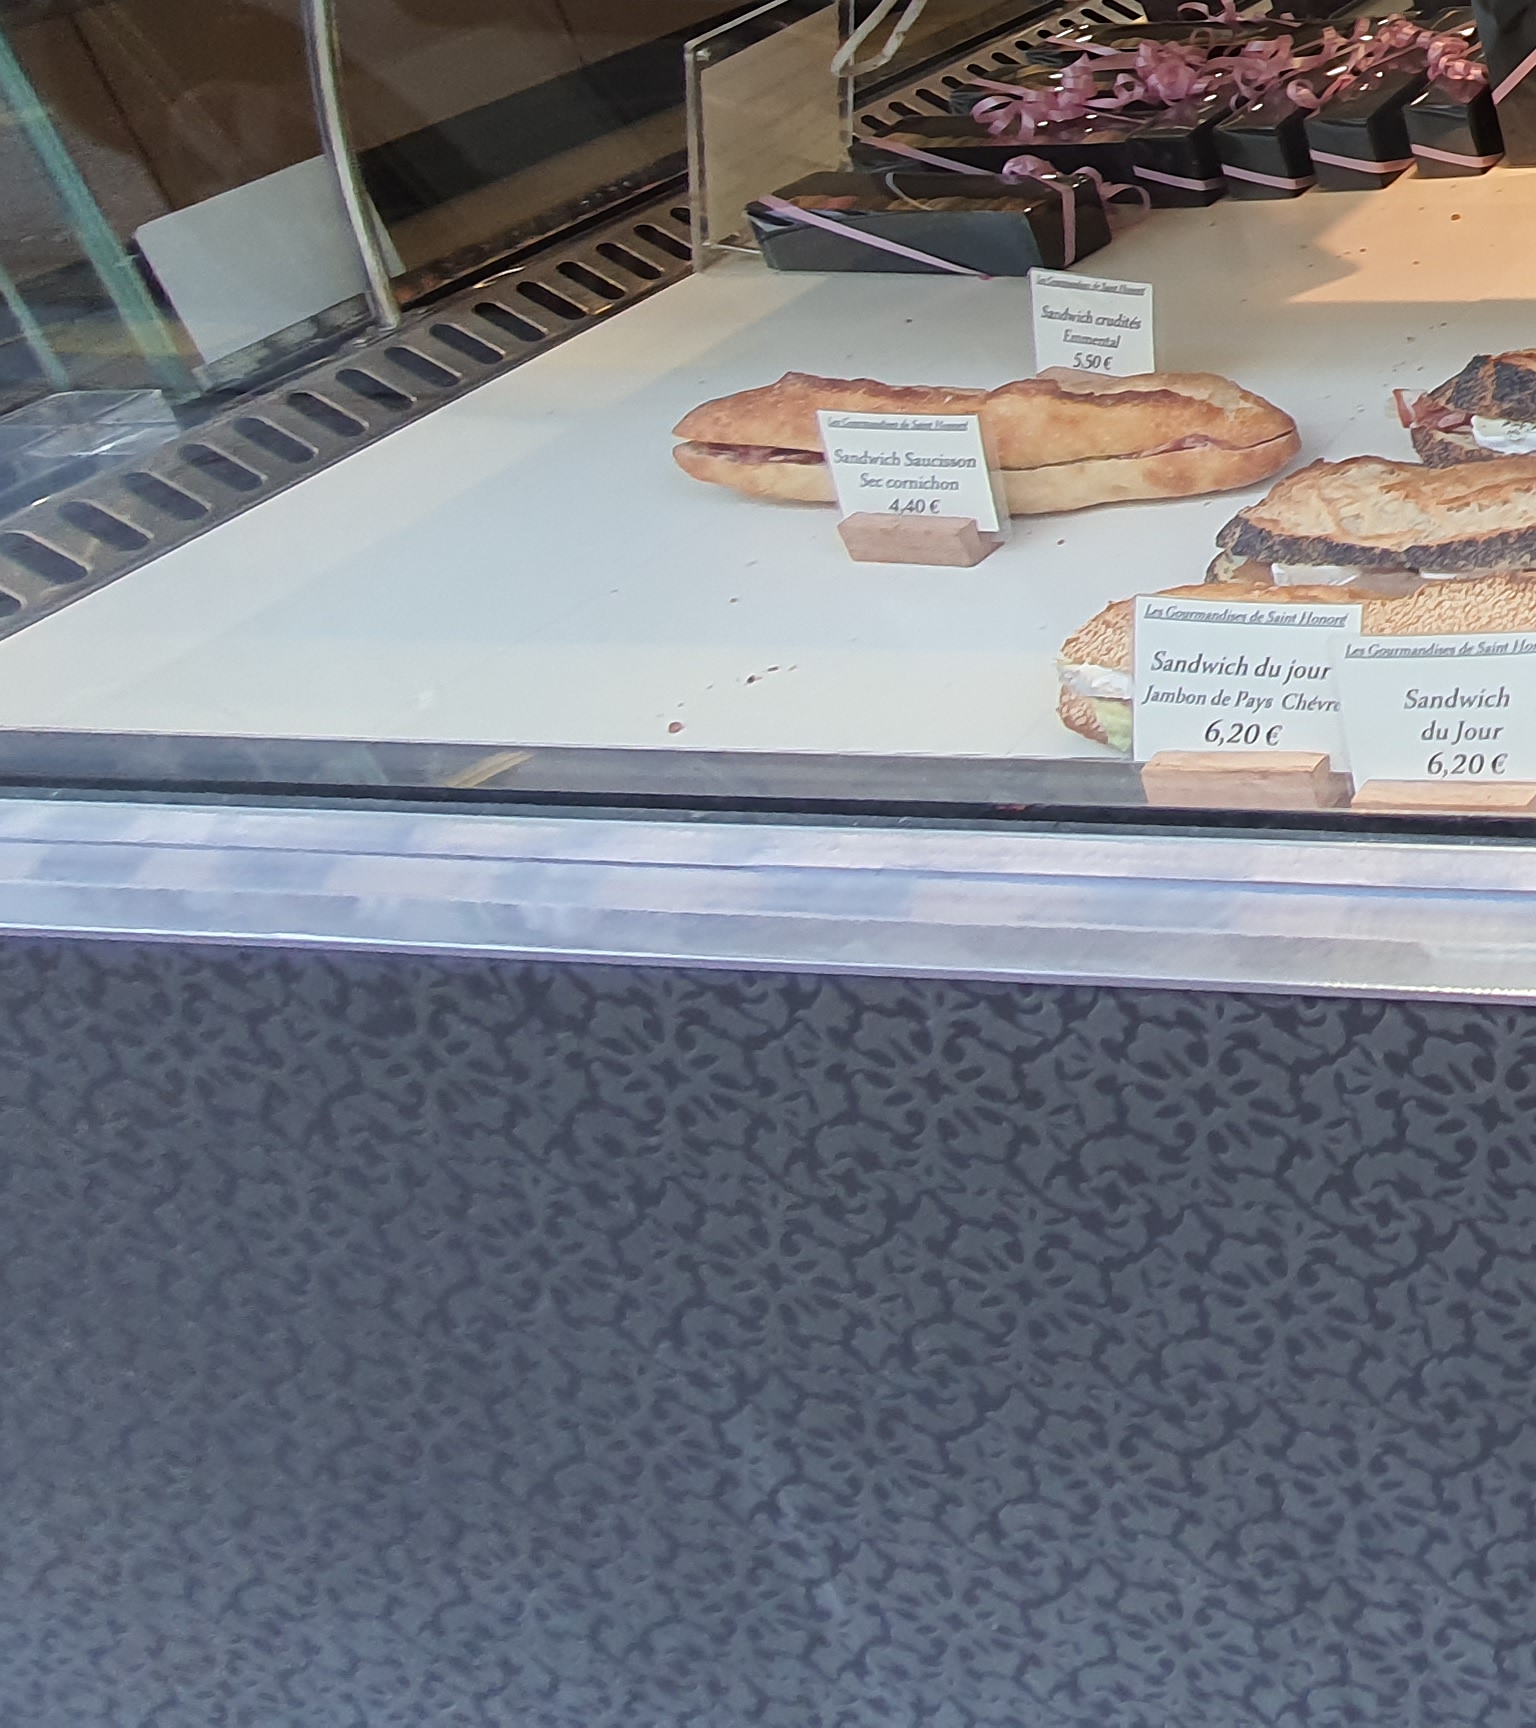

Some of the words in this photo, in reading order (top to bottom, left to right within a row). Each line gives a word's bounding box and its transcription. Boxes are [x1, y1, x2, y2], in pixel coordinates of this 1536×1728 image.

[1040, 304, 1093, 324] Sandwich
[1095, 313, 1142, 329] crudités
[1103, 355, 1113, 370] €
[833, 448, 901, 466] Sandwich
[903, 451, 977, 468] Saucisson
[859, 472, 882, 488] Sec
[886, 474, 960, 491] cornichon
[888, 498, 926, 515] 4,40
[929, 499, 941, 514] €
[1144, 604, 1163, 619] Les
[1165, 606, 1247, 623] Gourmandises
[1250, 610, 1264, 624] de
[1267, 610, 1296, 626] Saint
[1345, 643, 1364, 658] Les
[1368, 642, 1455, 659] Gourmandises
[1458, 642, 1474, 657] de
[1477, 641, 1508, 656] Saint
[1150, 650, 1248, 677] Sandwich
[1254, 656, 1281, 678] du
[1282, 659, 1333, 685] jour
[1141, 685, 1207, 706] Jambon
[1210, 689, 1231, 706] de
[1234, 691, 1273, 713] Pays
[1404, 686, 1511, 709] Sandwich
[1204, 718, 1260, 746] 6,20
[1266, 724, 1283, 746] €
[1421, 720, 1449, 741] du
[1451, 720, 1504, 746] Jour
[1427, 751, 1485, 778] 6,20
[1491, 753, 1508, 775] €
